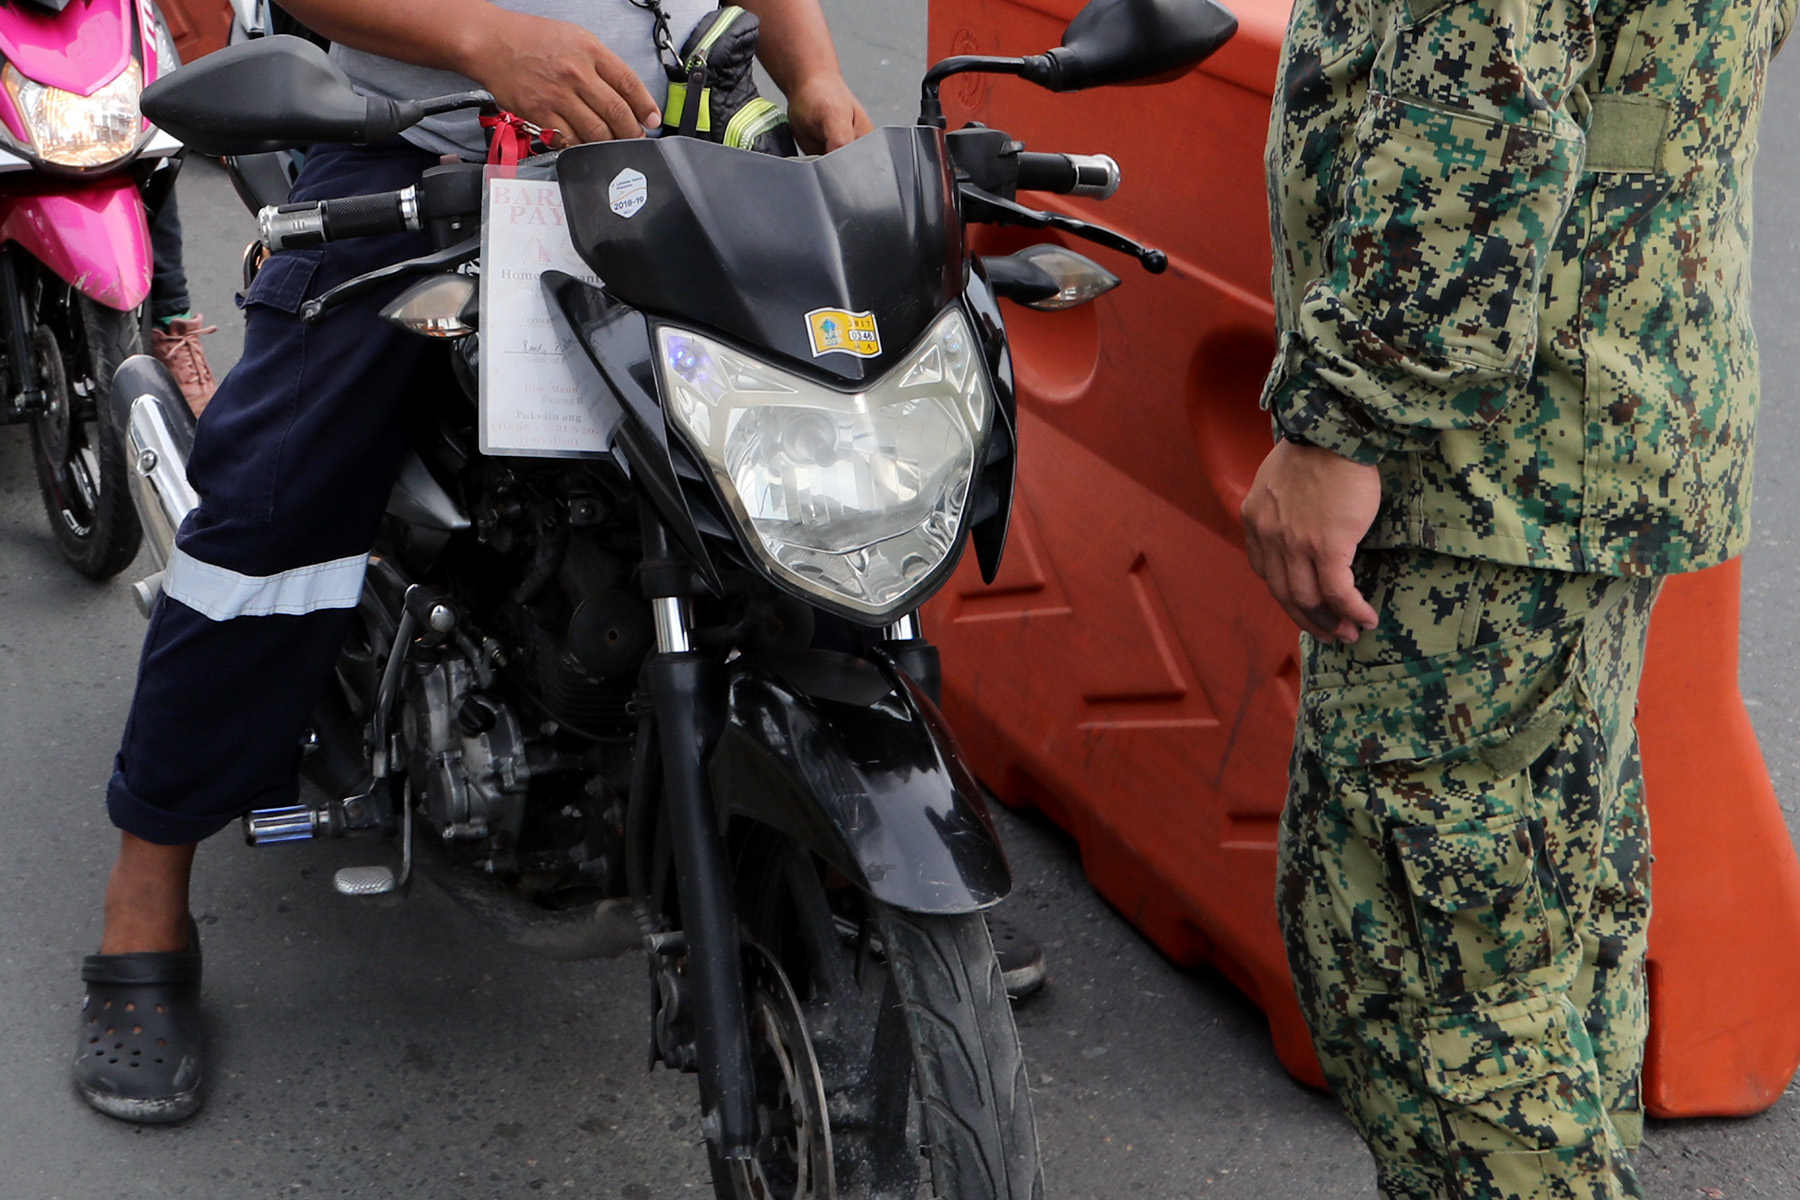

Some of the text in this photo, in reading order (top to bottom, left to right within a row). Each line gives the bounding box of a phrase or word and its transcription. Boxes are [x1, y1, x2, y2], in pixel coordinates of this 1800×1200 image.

[613, 196, 644, 210] 2018-19
[501, 269, 540, 281] Home
[848, 320, 871, 328] 2017
[516, 411, 582, 423] Puksain ang
